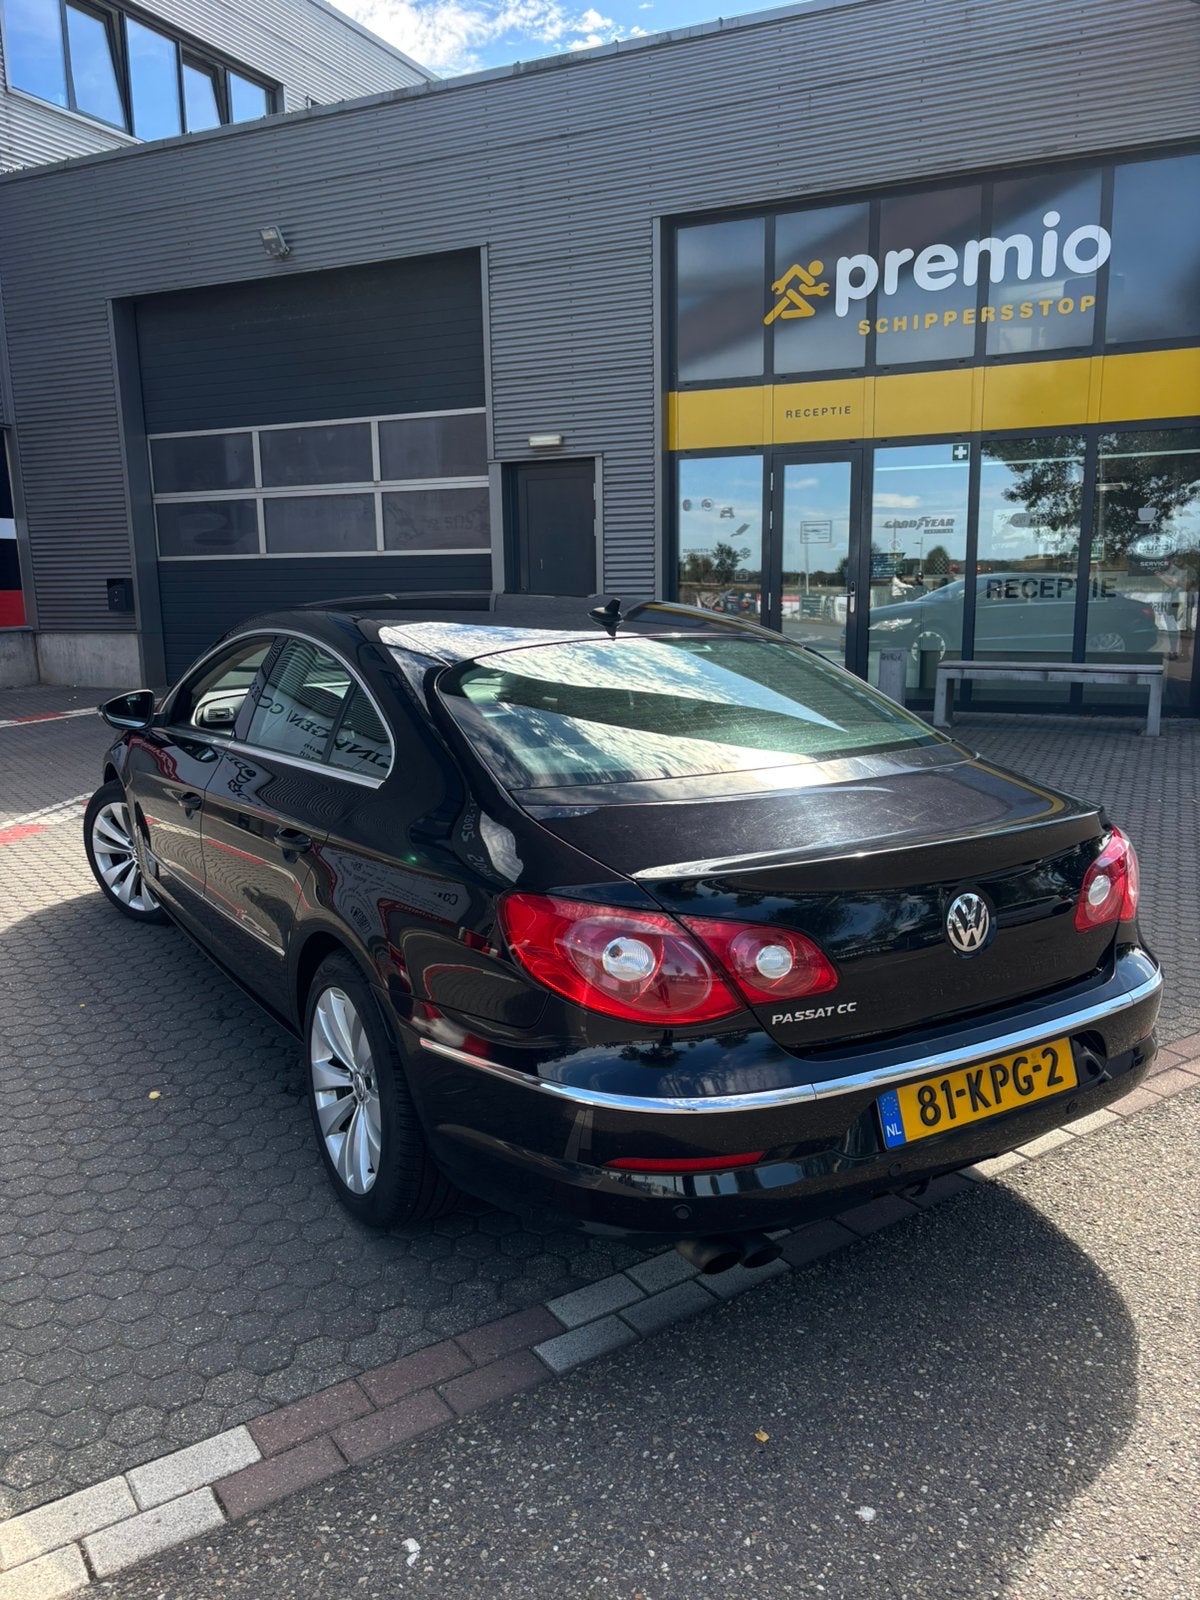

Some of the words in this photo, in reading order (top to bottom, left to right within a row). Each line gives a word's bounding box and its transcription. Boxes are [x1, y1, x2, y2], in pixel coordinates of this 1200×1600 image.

[835, 210, 1112, 318] premio
[858, 295, 1097, 337] SCHIPPERSSTOP
[785, 405, 852, 419] RECEPTIE
[985, 576, 1118, 600] RECEPIE
[771, 1006, 835, 1025] PASSAT
[836, 1001, 857, 1015] CC
[917, 1047, 1064, 1127] 81-KPG-2
[886, 1122, 902, 1139] NL
